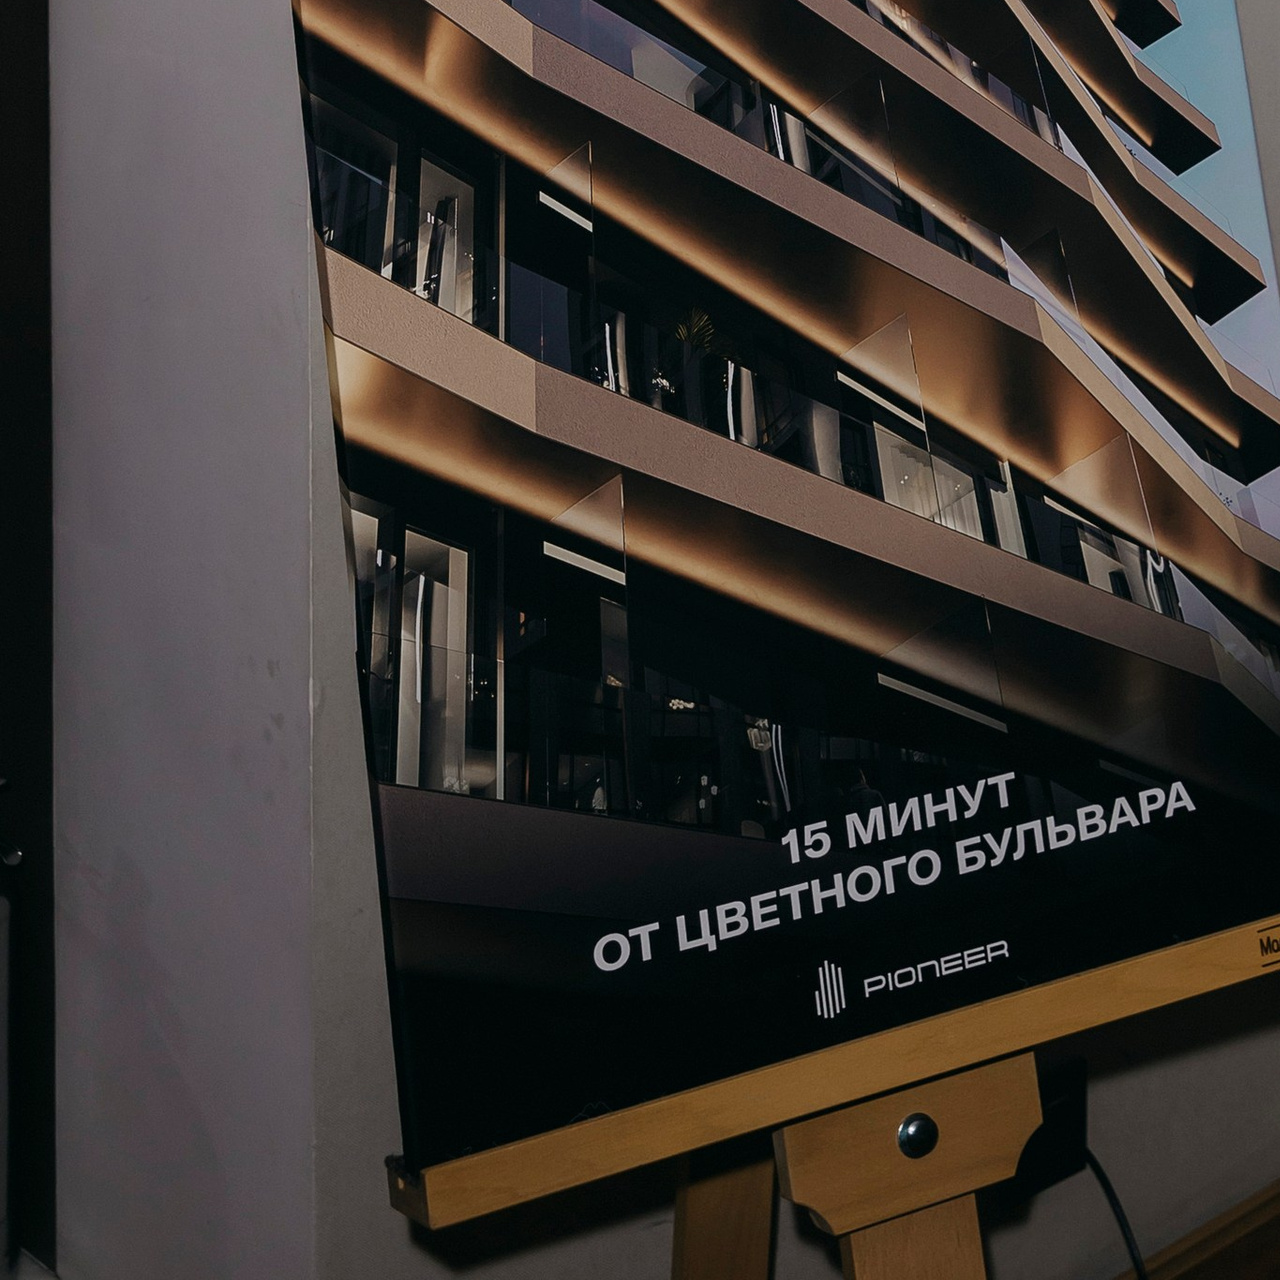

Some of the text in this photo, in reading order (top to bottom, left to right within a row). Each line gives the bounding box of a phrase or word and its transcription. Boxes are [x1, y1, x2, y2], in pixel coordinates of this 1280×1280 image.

[781, 772, 1016, 864] 15 МИНУТ
[593, 781, 1197, 972] ОТ ЦВЕТНОГО БУЛЬВАРА
[863, 940, 1010, 998] PIONEER
